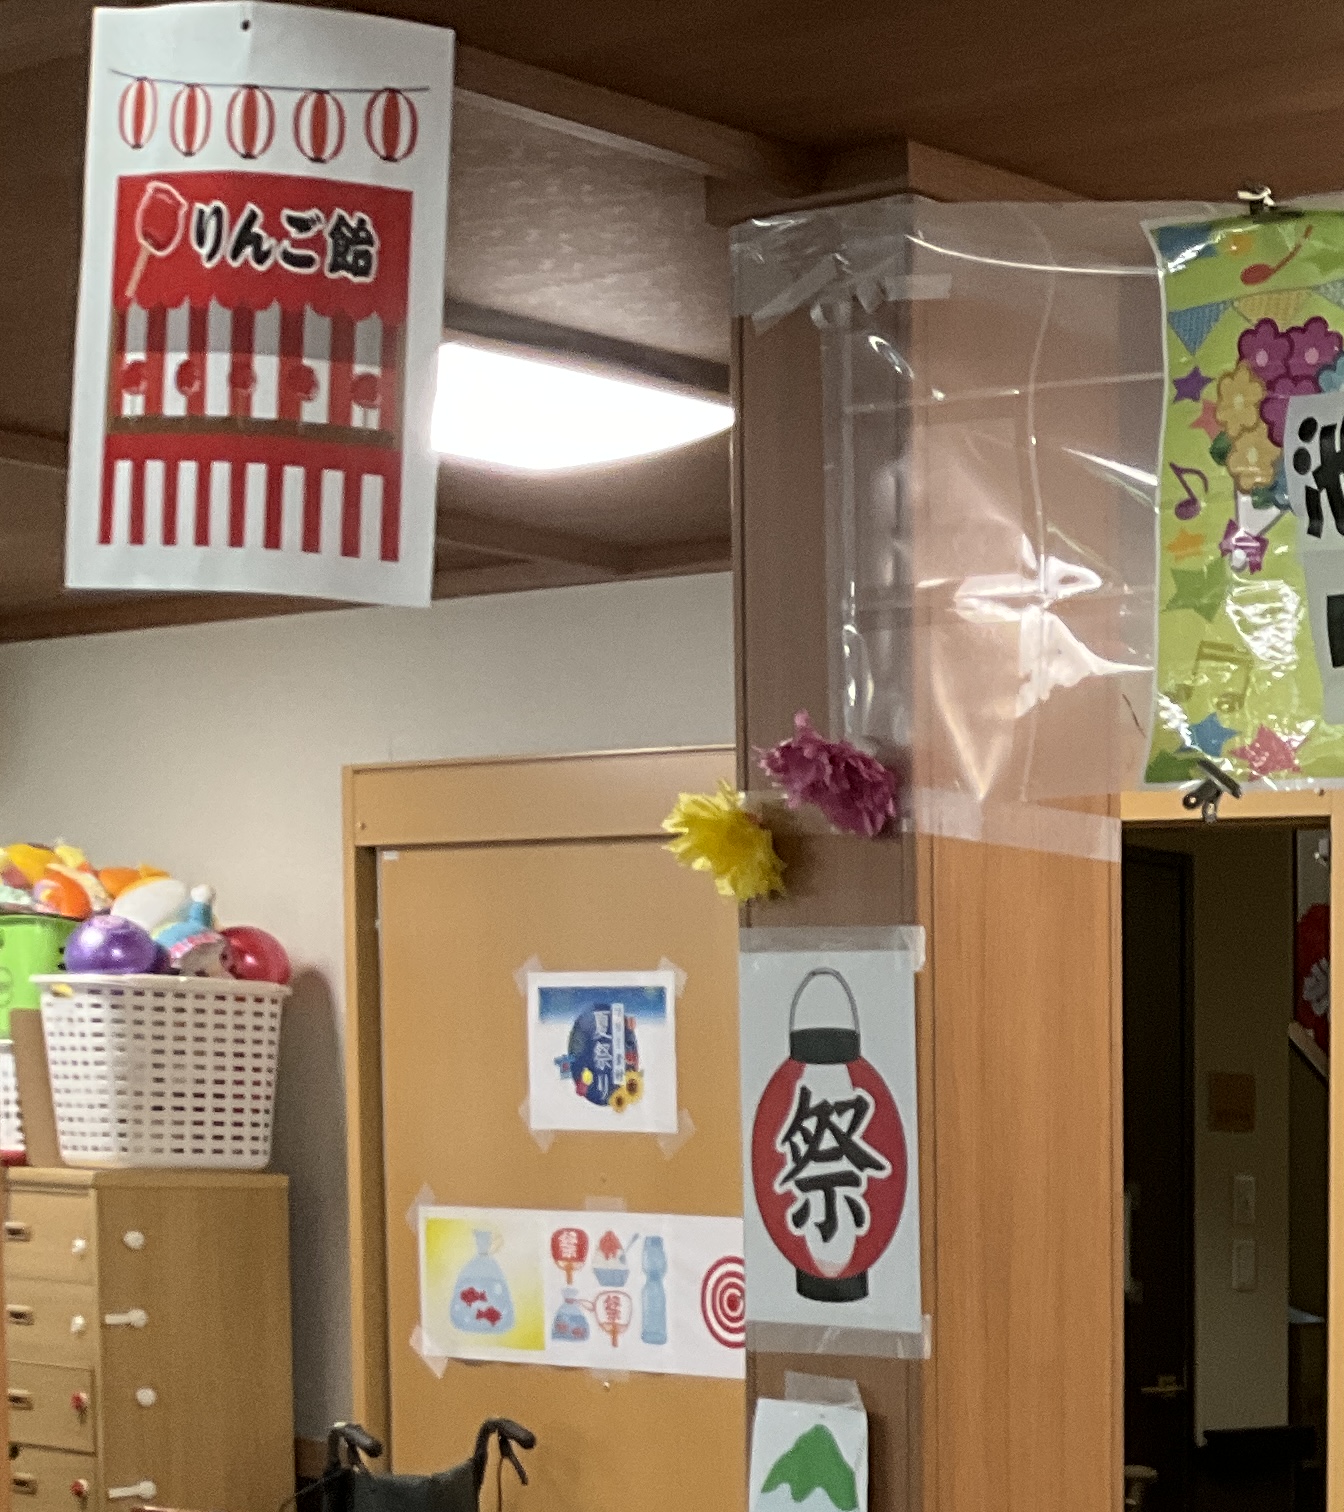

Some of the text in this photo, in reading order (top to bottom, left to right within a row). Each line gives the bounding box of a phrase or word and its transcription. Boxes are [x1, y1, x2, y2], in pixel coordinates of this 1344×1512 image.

[193, 201, 378, 280] りんご飴
[780, 1085, 889, 1243] 祭
